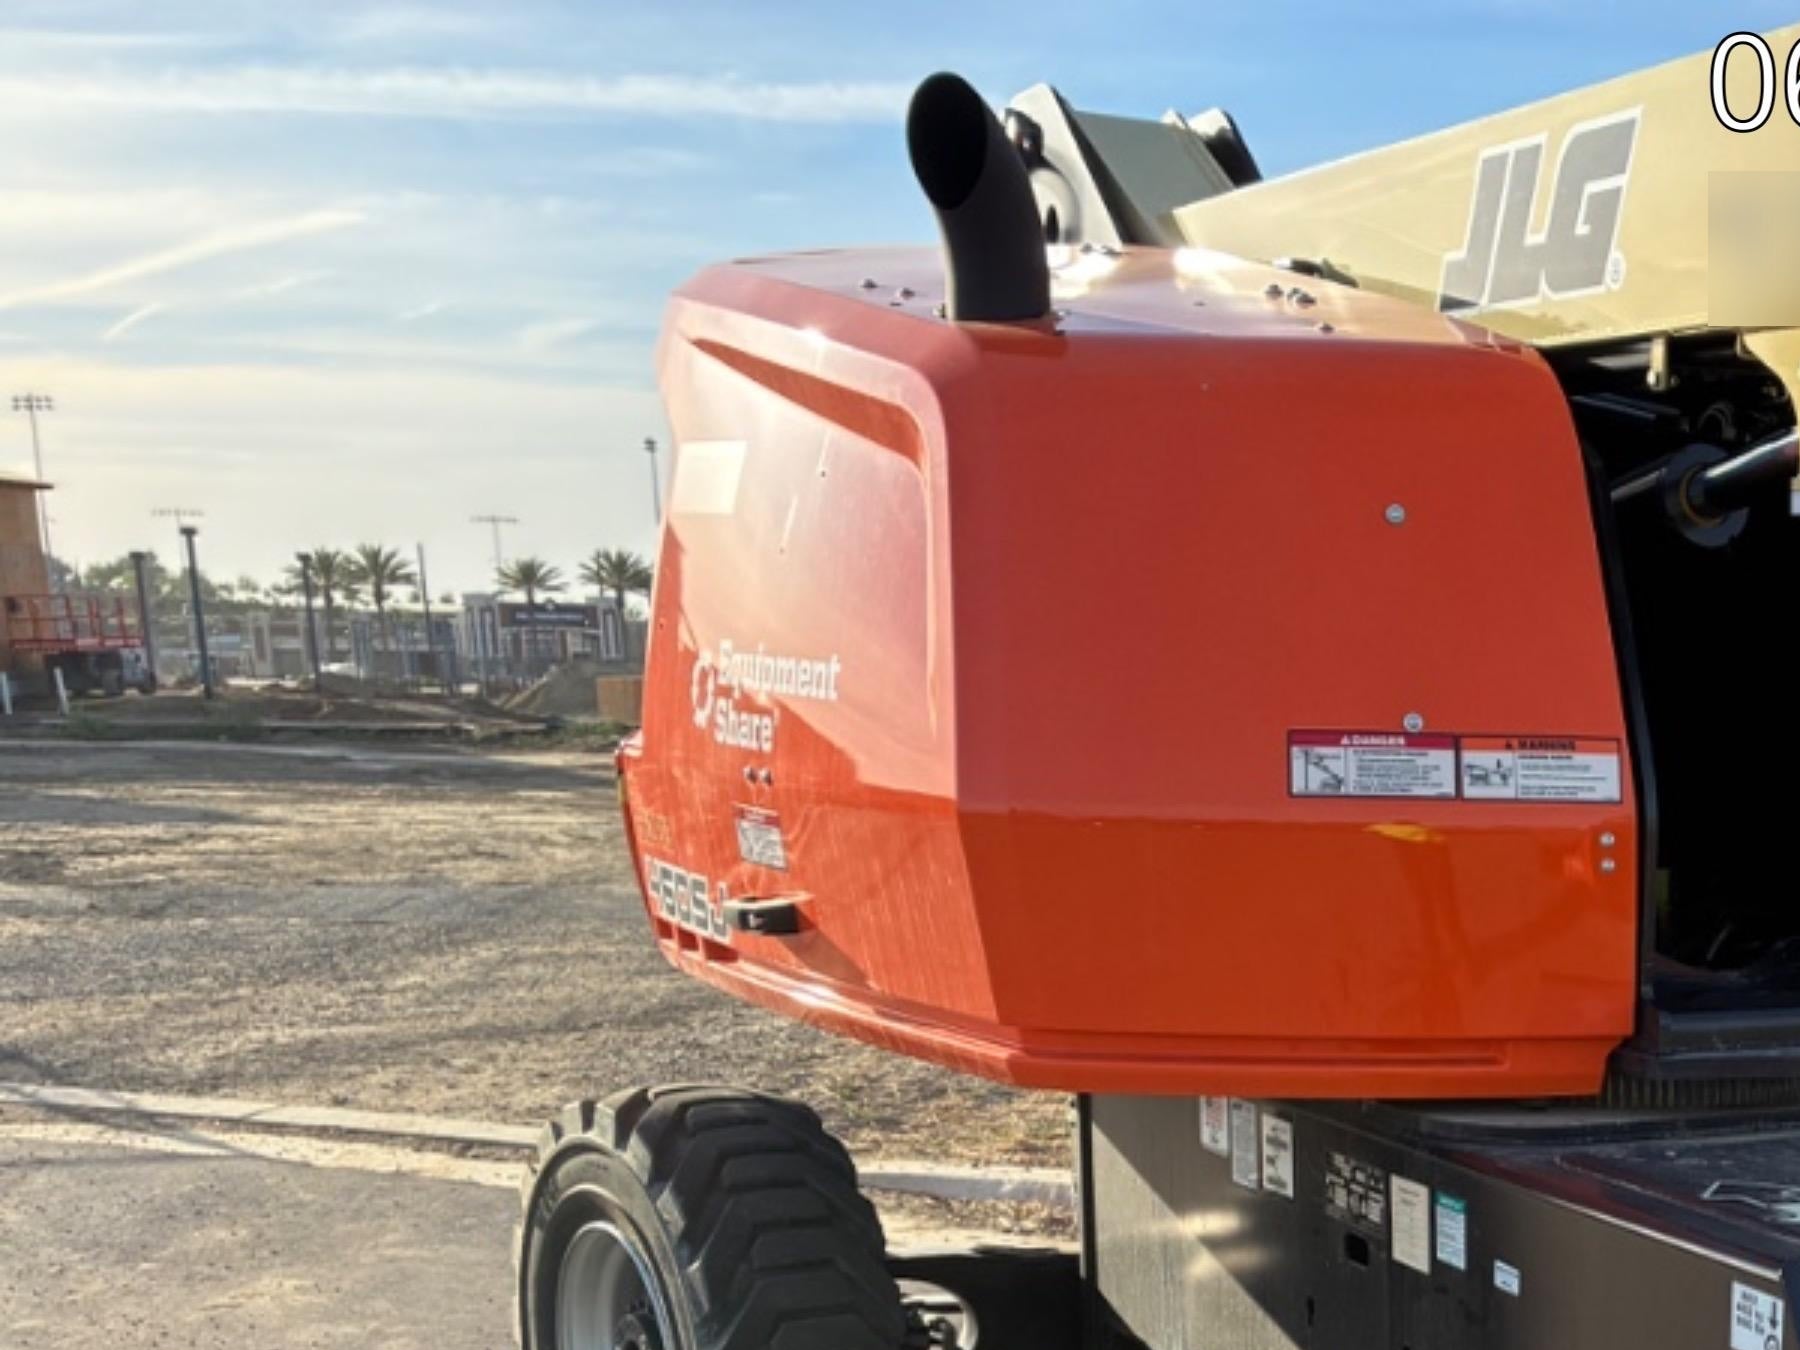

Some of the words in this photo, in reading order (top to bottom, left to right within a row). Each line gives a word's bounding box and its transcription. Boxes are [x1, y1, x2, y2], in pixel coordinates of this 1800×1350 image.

[1436, 104, 1643, 316] JLG
[718, 638, 840, 701] Equipment
[714, 696, 774, 753] Share
